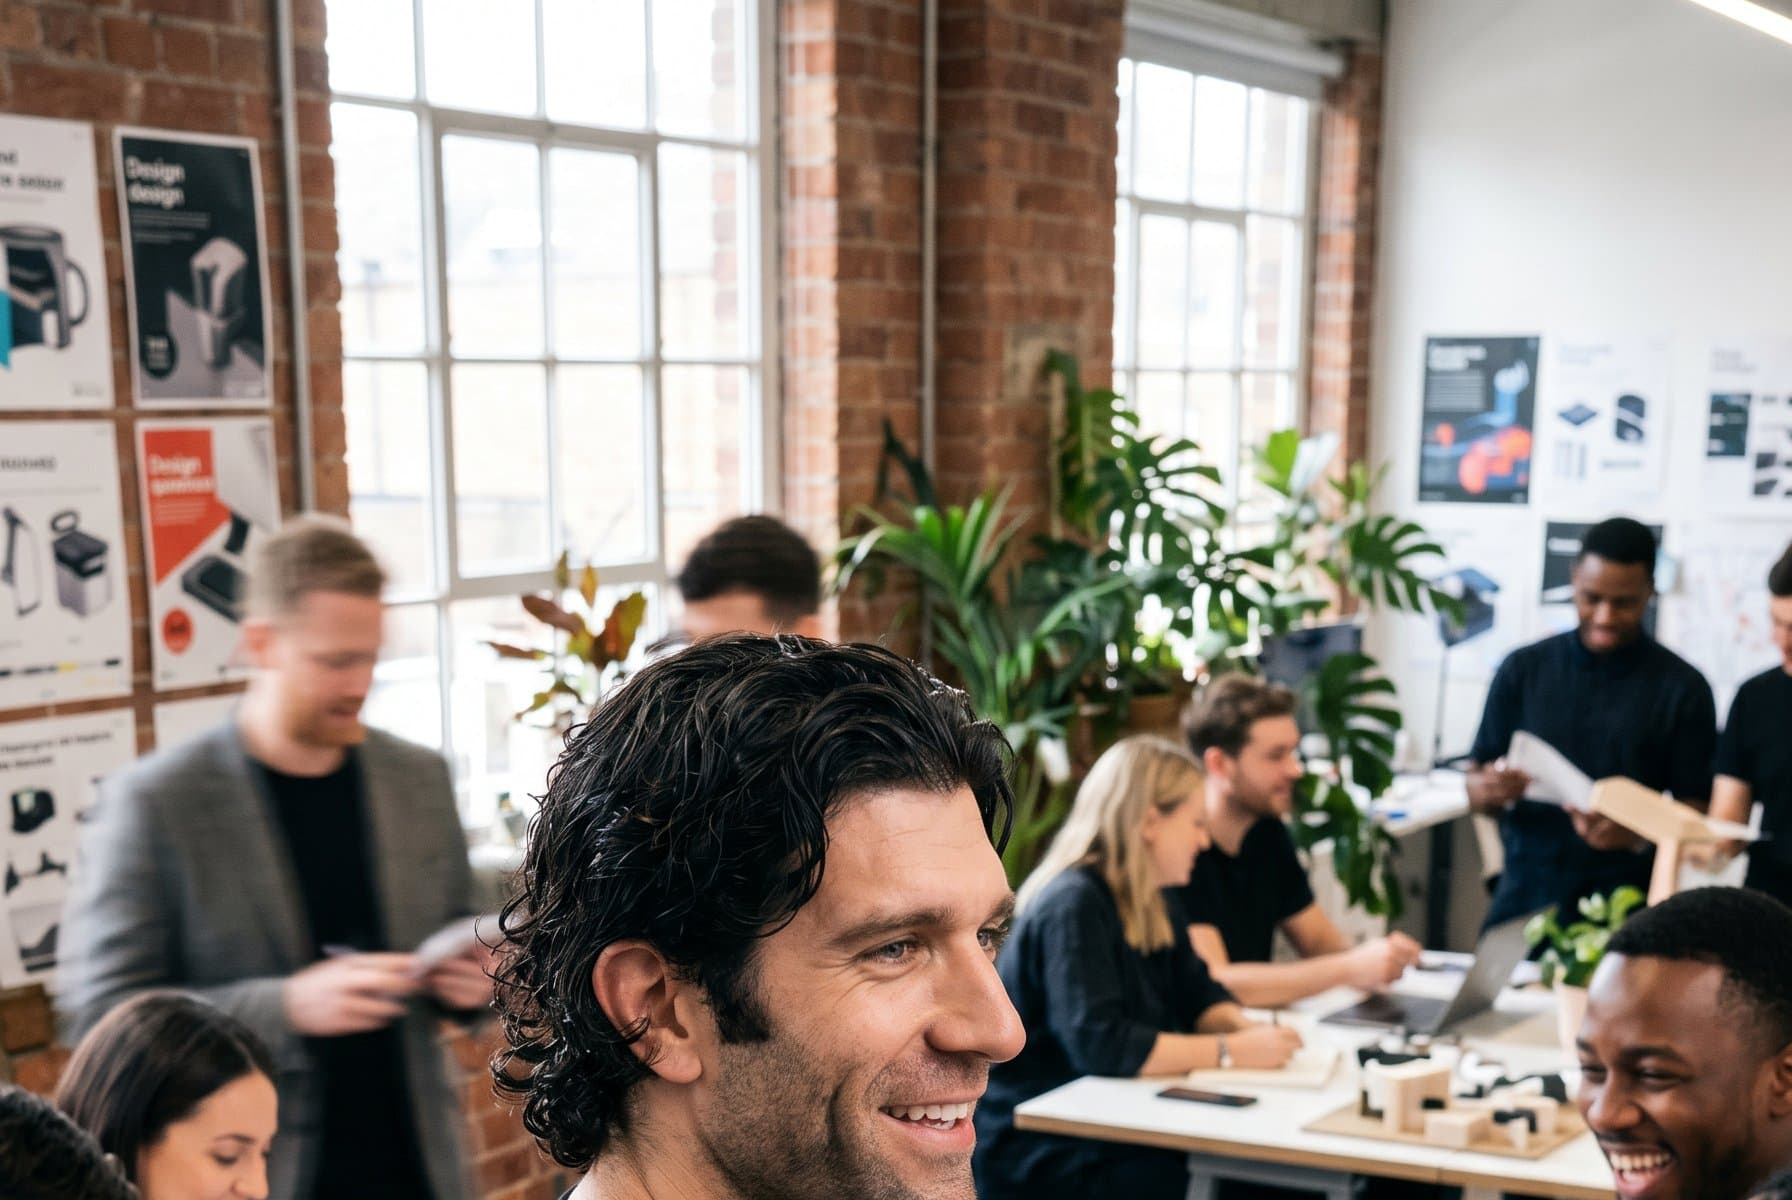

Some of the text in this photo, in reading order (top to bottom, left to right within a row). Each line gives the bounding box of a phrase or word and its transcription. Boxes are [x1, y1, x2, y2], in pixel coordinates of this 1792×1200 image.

[125, 156, 185, 185] Design
[127, 183, 185, 209] design
[149, 455, 201, 480] Design
